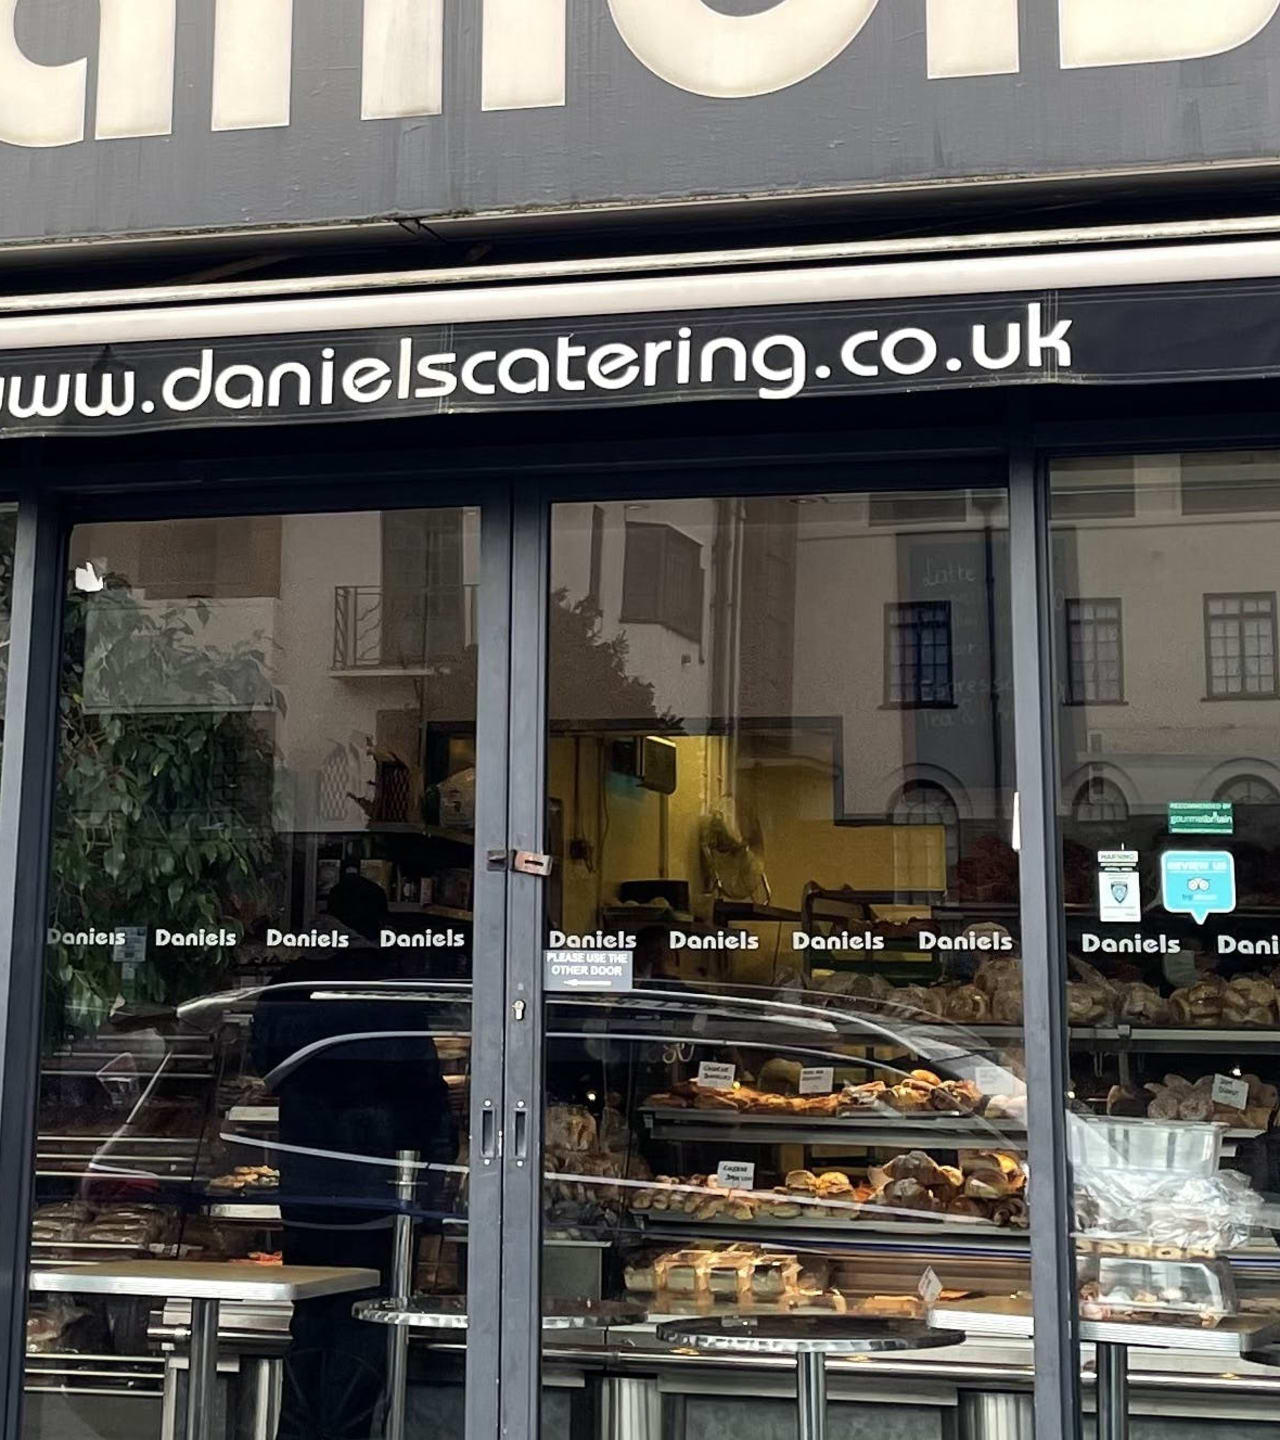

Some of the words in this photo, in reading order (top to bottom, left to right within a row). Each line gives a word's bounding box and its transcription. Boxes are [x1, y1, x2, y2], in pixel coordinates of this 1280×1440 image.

[46, 927, 126, 946] Daniels
[155, 928, 237, 947] Daniels
[266, 928, 350, 949] Daniels
[380, 928, 466, 948] Daniels
[549, 930, 637, 949] Daniels
[669, 930, 759, 951] Daniels
[792, 930, 885, 951] Daniels
[919, 931, 1013, 952] Daniels
[1081, 933, 1181, 954] Daniels
[546, 952, 585, 963] PLEASE
[586, 952, 607, 963] USE
[608, 953, 628, 964] THE
[551, 965, 589, 976] OTHER
[590, 965, 622, 976] DOOR
